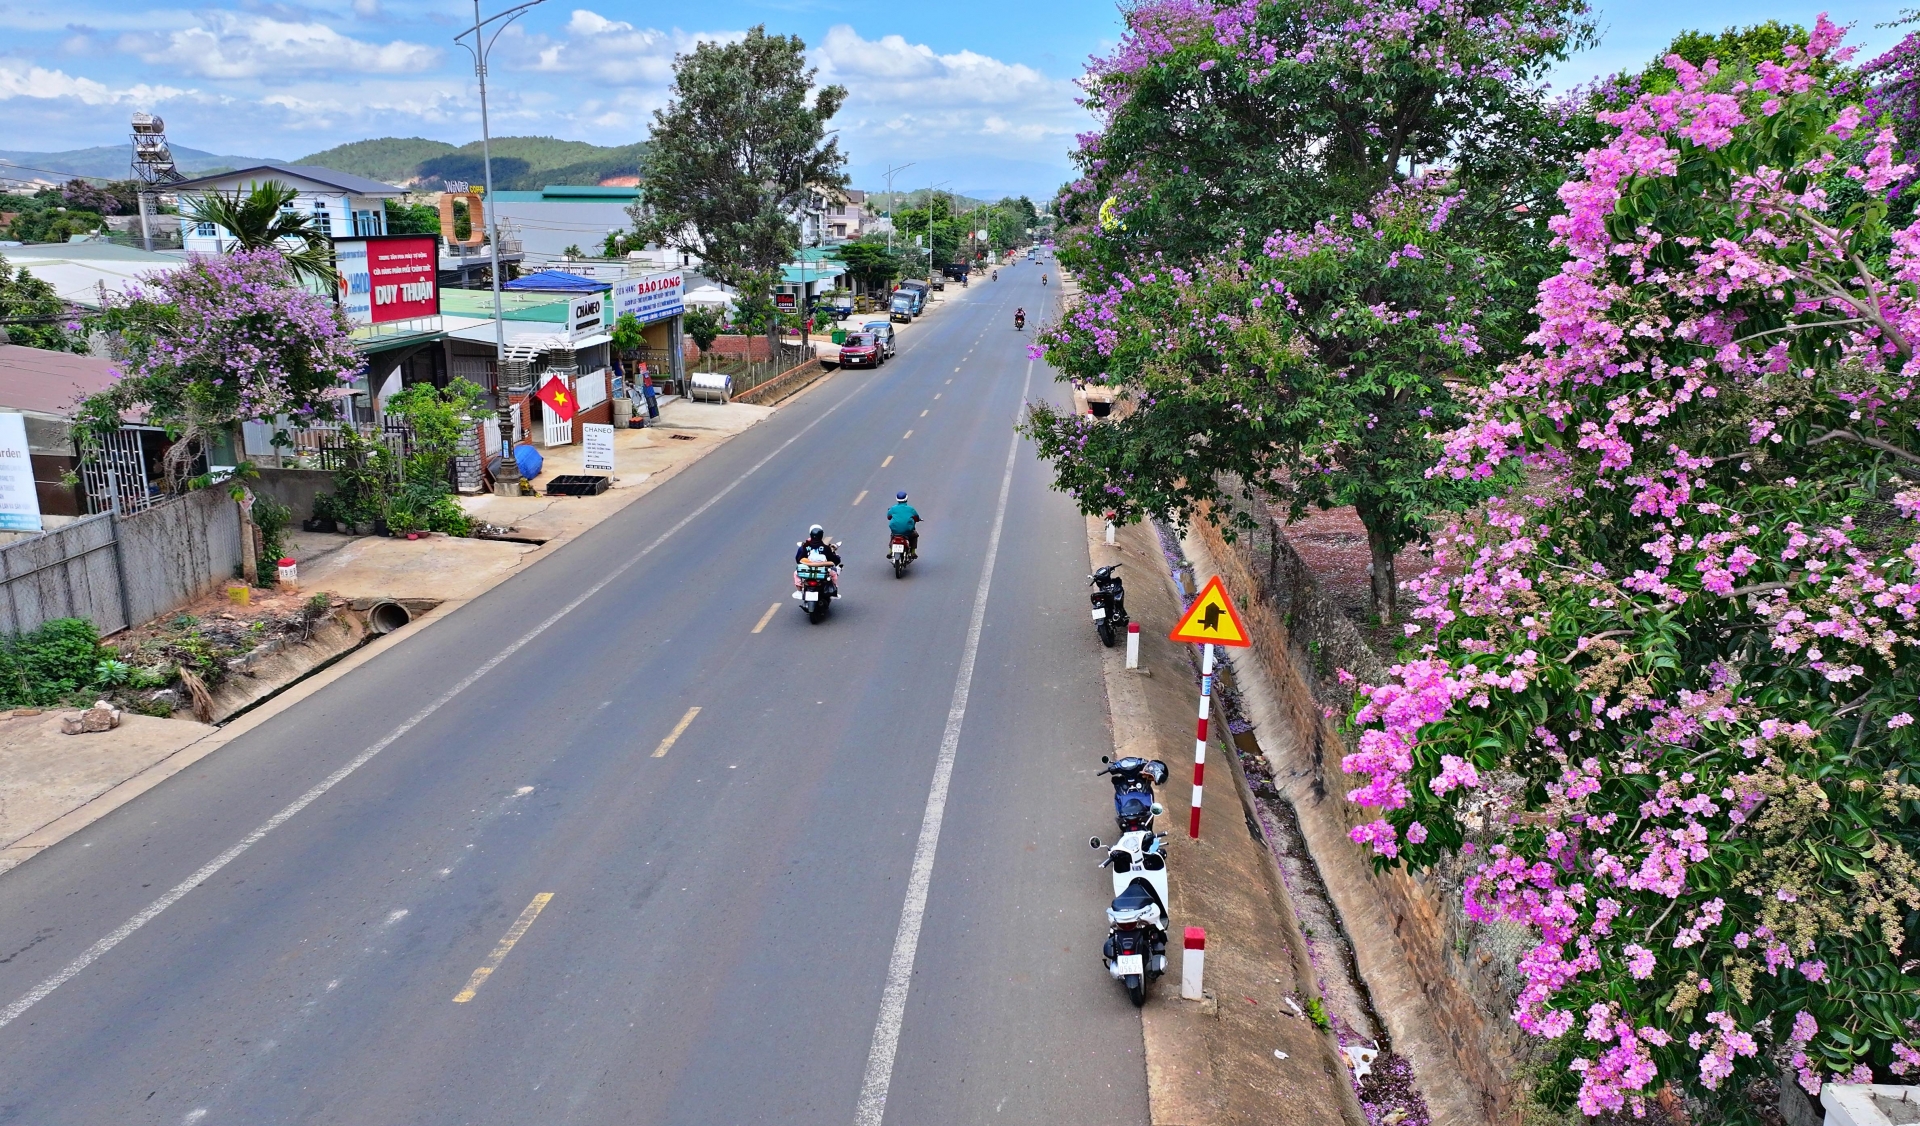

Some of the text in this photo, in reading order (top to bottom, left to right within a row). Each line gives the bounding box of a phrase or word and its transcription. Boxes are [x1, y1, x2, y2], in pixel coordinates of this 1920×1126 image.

[375, 284, 398, 305] DUY
[400, 276, 433, 304] THUẬN
[638, 276, 656, 295] BẢO
[657, 275, 680, 291] LONG
